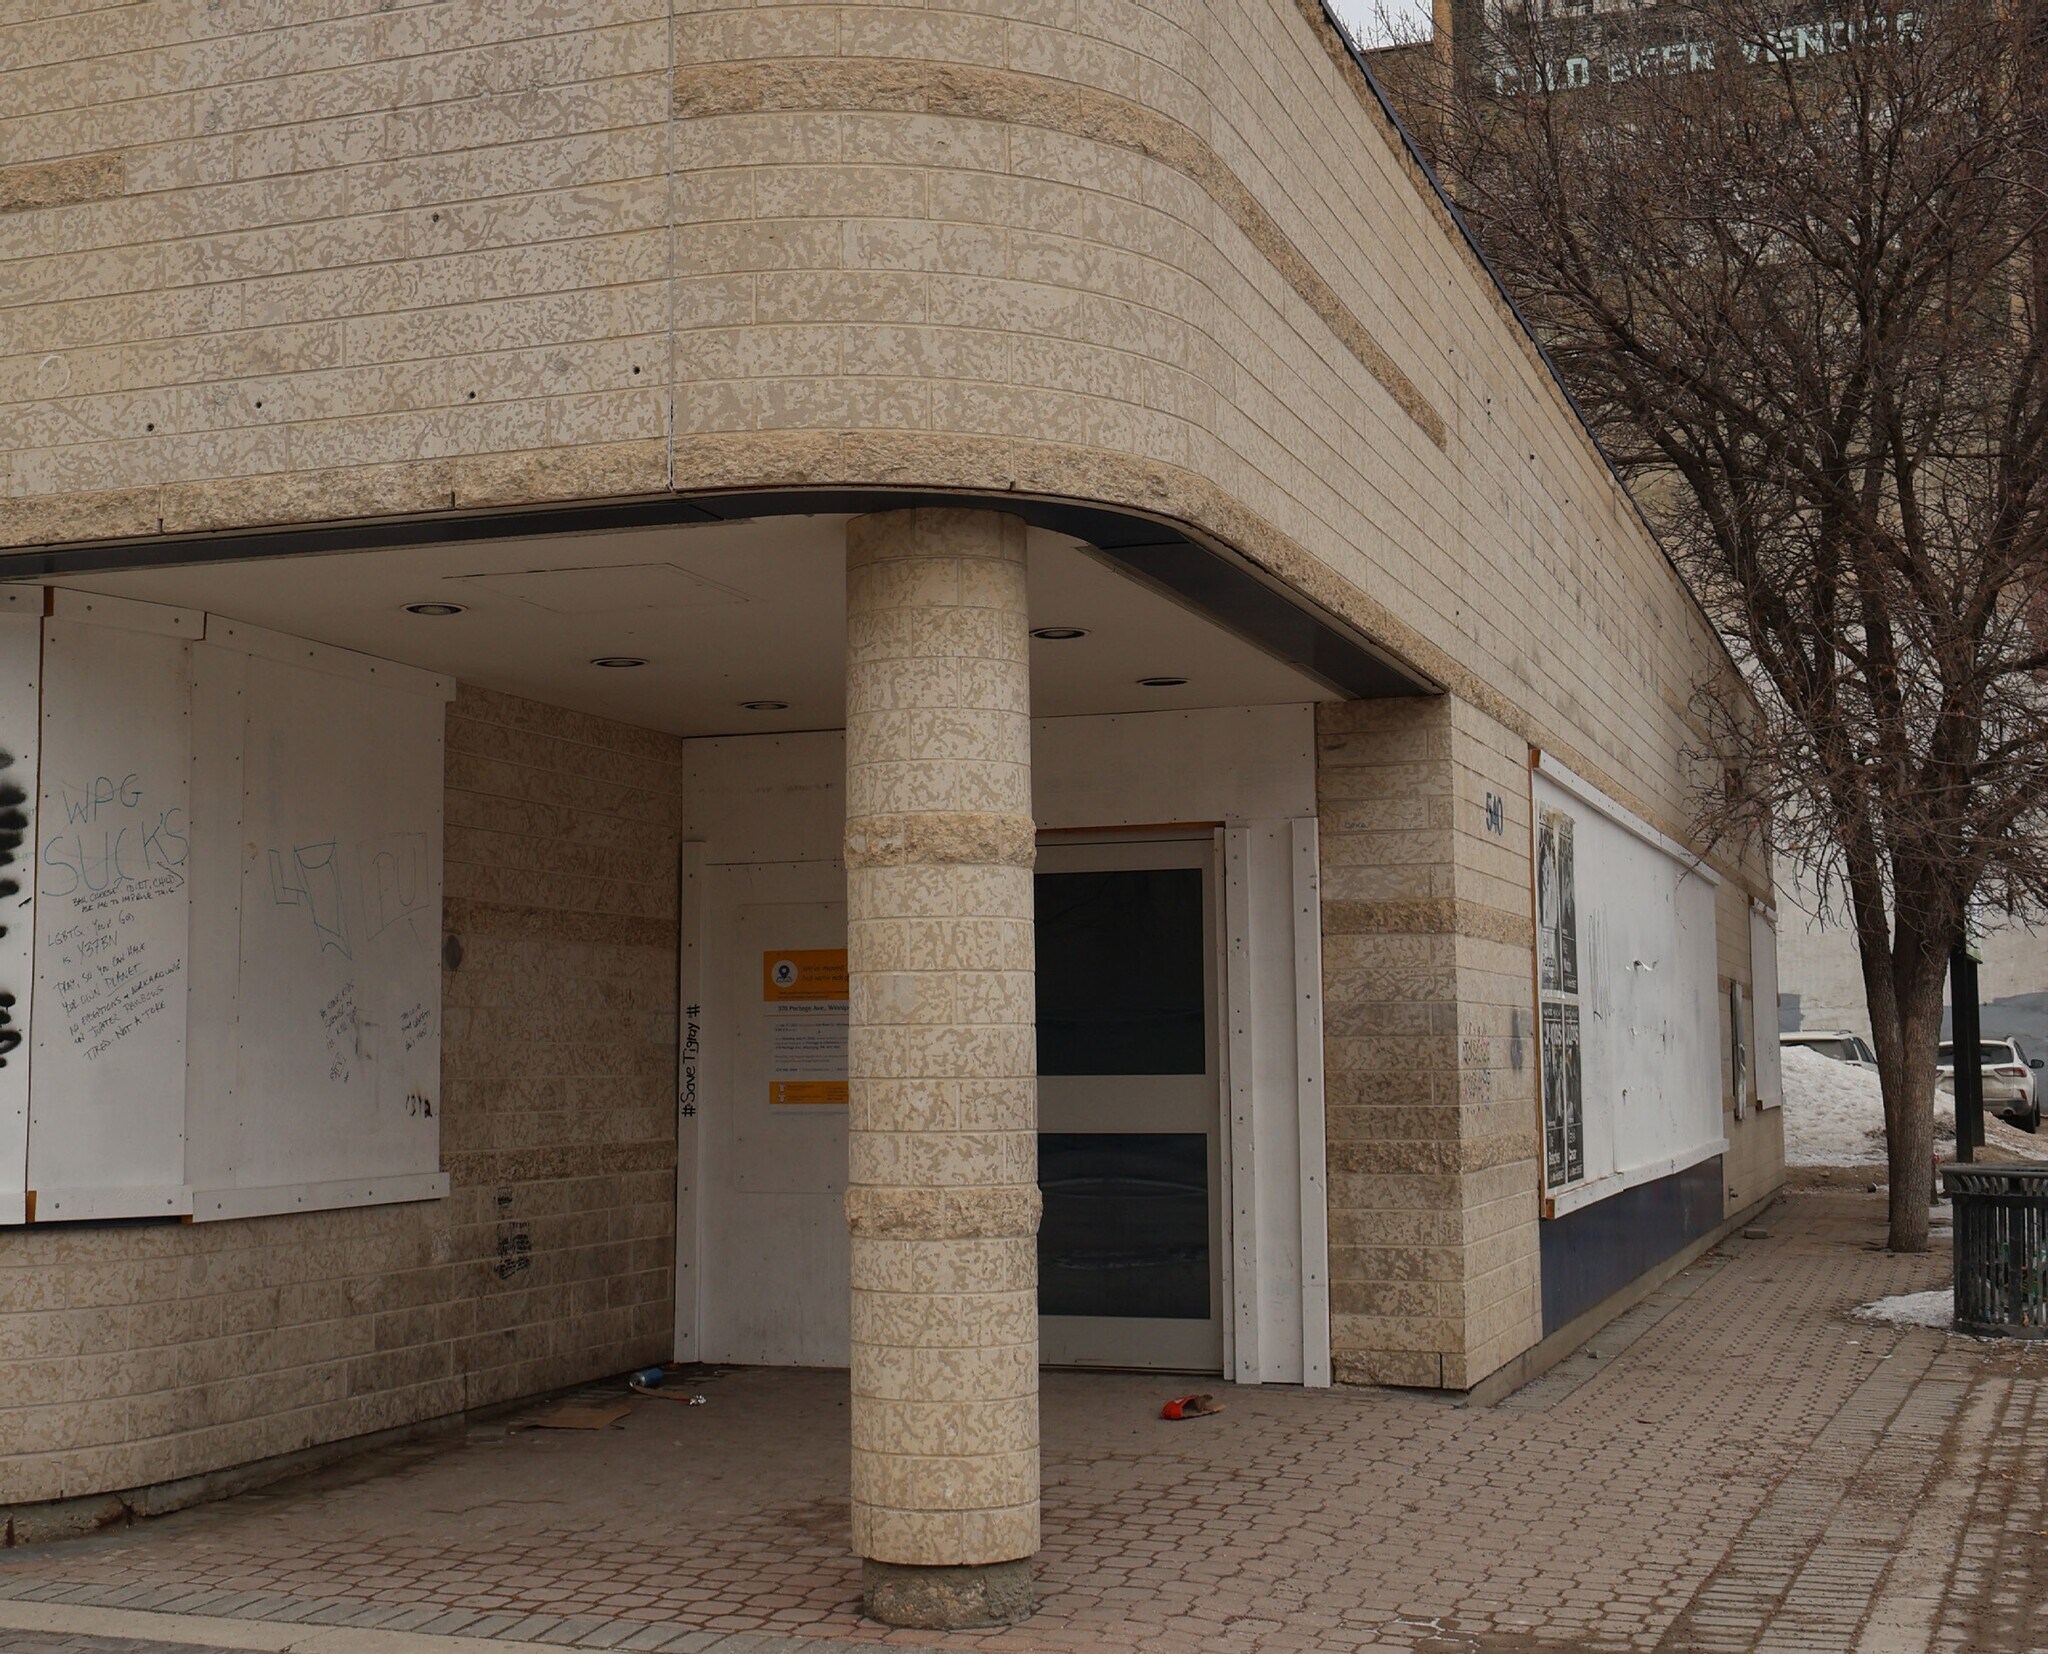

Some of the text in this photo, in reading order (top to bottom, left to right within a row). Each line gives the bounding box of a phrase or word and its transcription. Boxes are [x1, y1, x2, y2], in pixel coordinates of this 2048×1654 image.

[62, 774, 143, 825] WPG
[1486, 792, 1504, 837] 540
[44, 808, 189, 896] SUCKS
